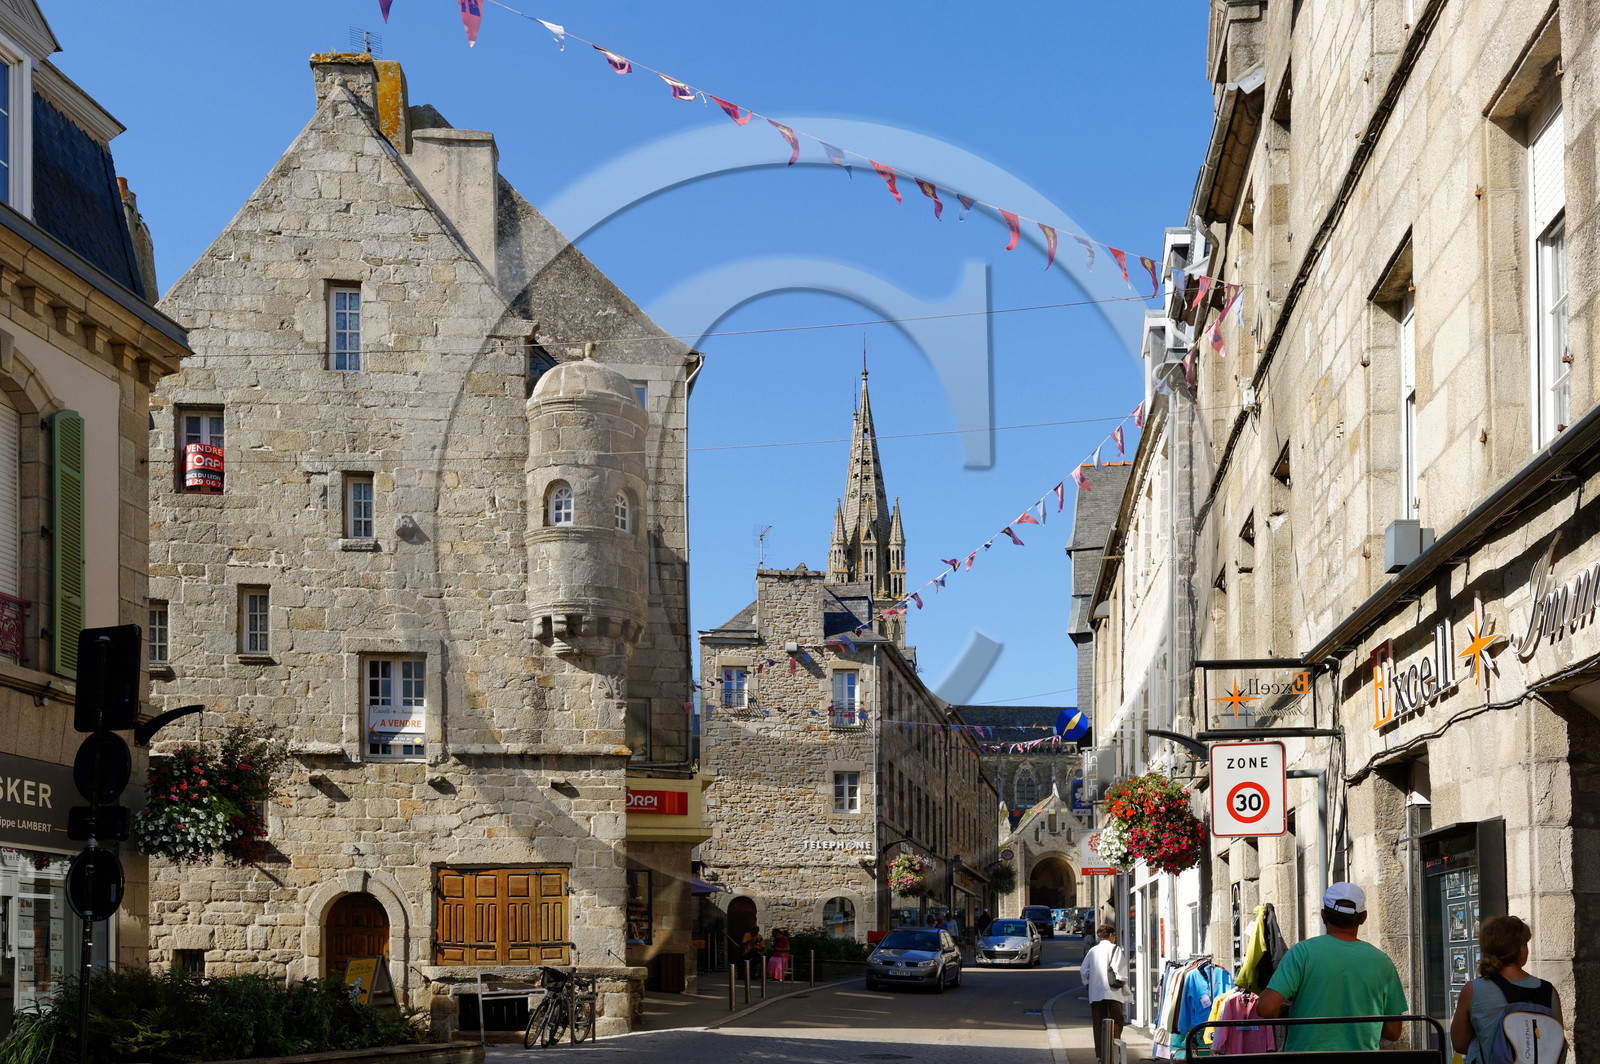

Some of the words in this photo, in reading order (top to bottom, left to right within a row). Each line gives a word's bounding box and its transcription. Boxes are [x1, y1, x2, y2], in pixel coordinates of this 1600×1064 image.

[187, 444, 222, 456] VENDRE
[1371, 617, 1457, 730] Excell
[380, 719, 386, 727] A
[388, 719, 422, 727] VENDRE
[1226, 757, 1269, 769] ZONE
[1235, 793, 1262, 812] 30
[17, 819, 52, 833] LAMBERT
